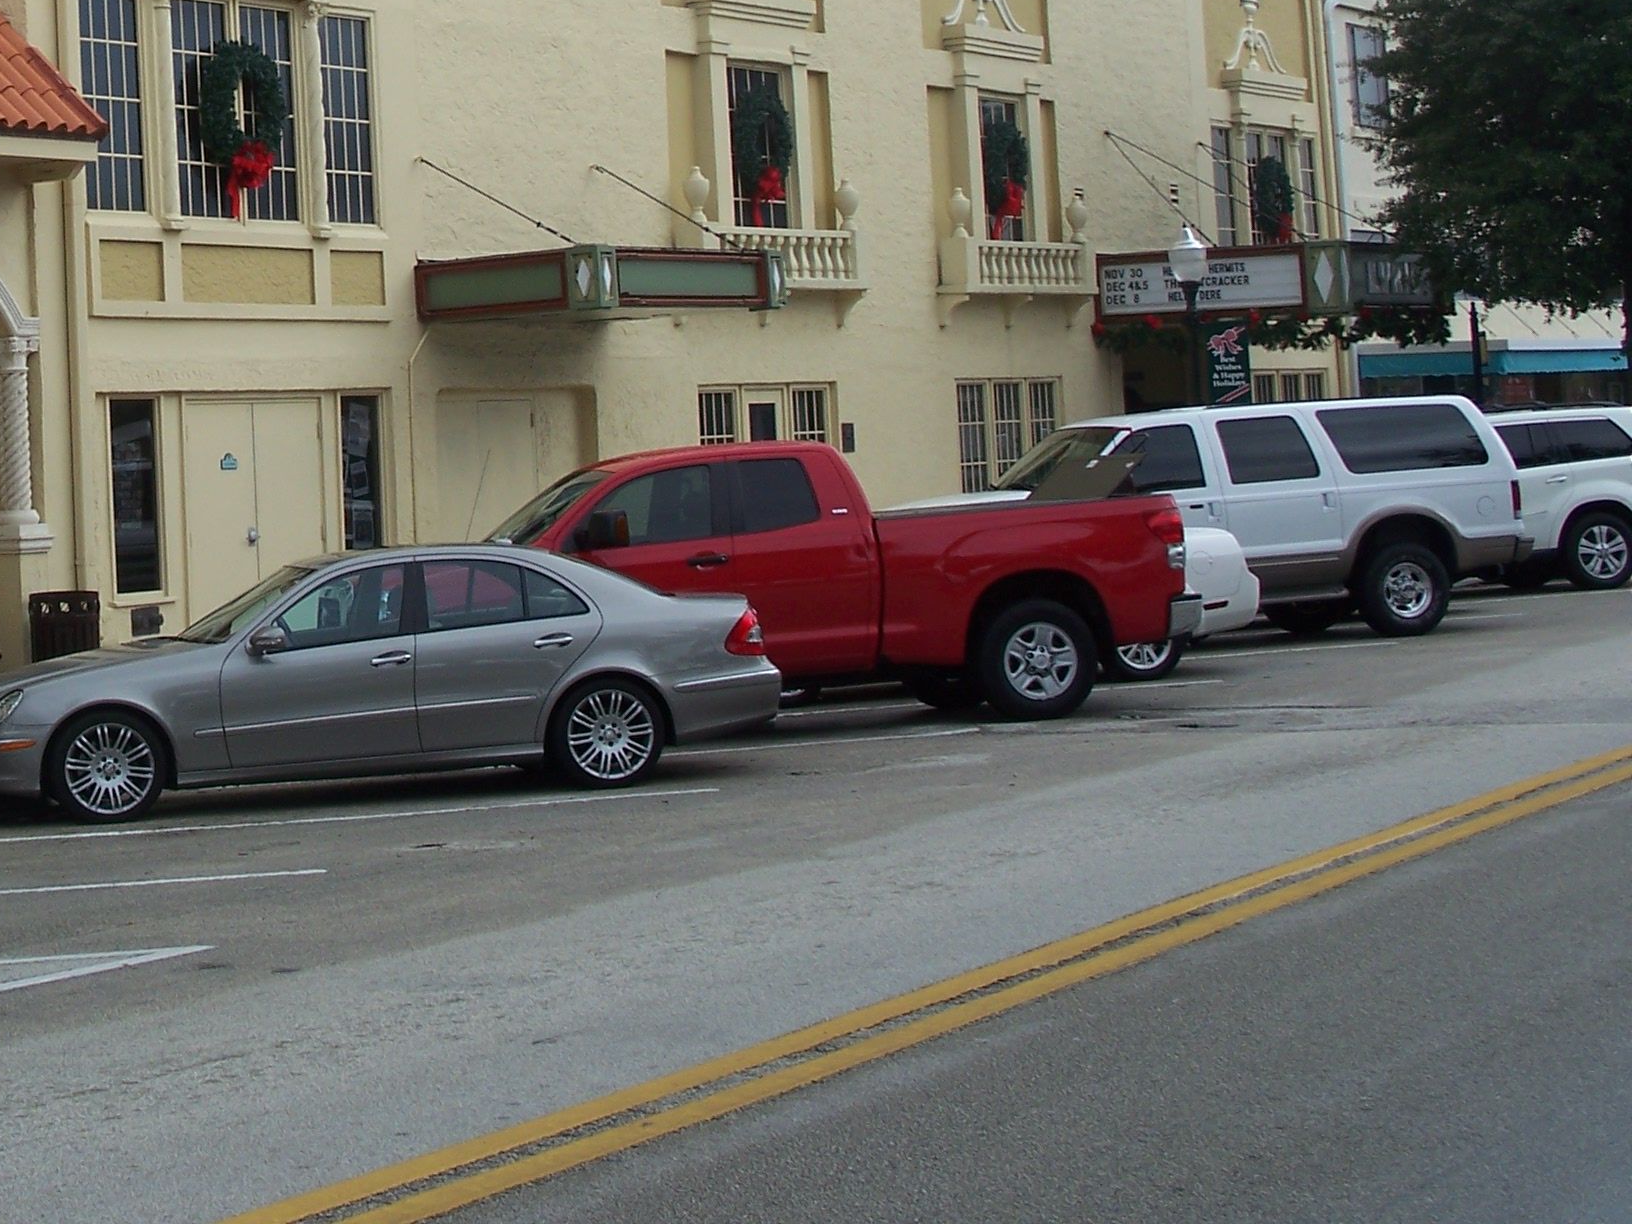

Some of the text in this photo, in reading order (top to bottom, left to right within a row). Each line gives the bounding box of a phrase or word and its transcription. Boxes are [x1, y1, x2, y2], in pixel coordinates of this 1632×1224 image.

[1104, 262, 1245, 280] NOV 30 HERMITS
[1106, 281, 1126, 292] DEC
[1165, 278, 1183, 290] TH
[1106, 294, 1126, 305] DEC
[1133, 293, 1140, 304] 8
[1199, 289, 1222, 300] DERE
